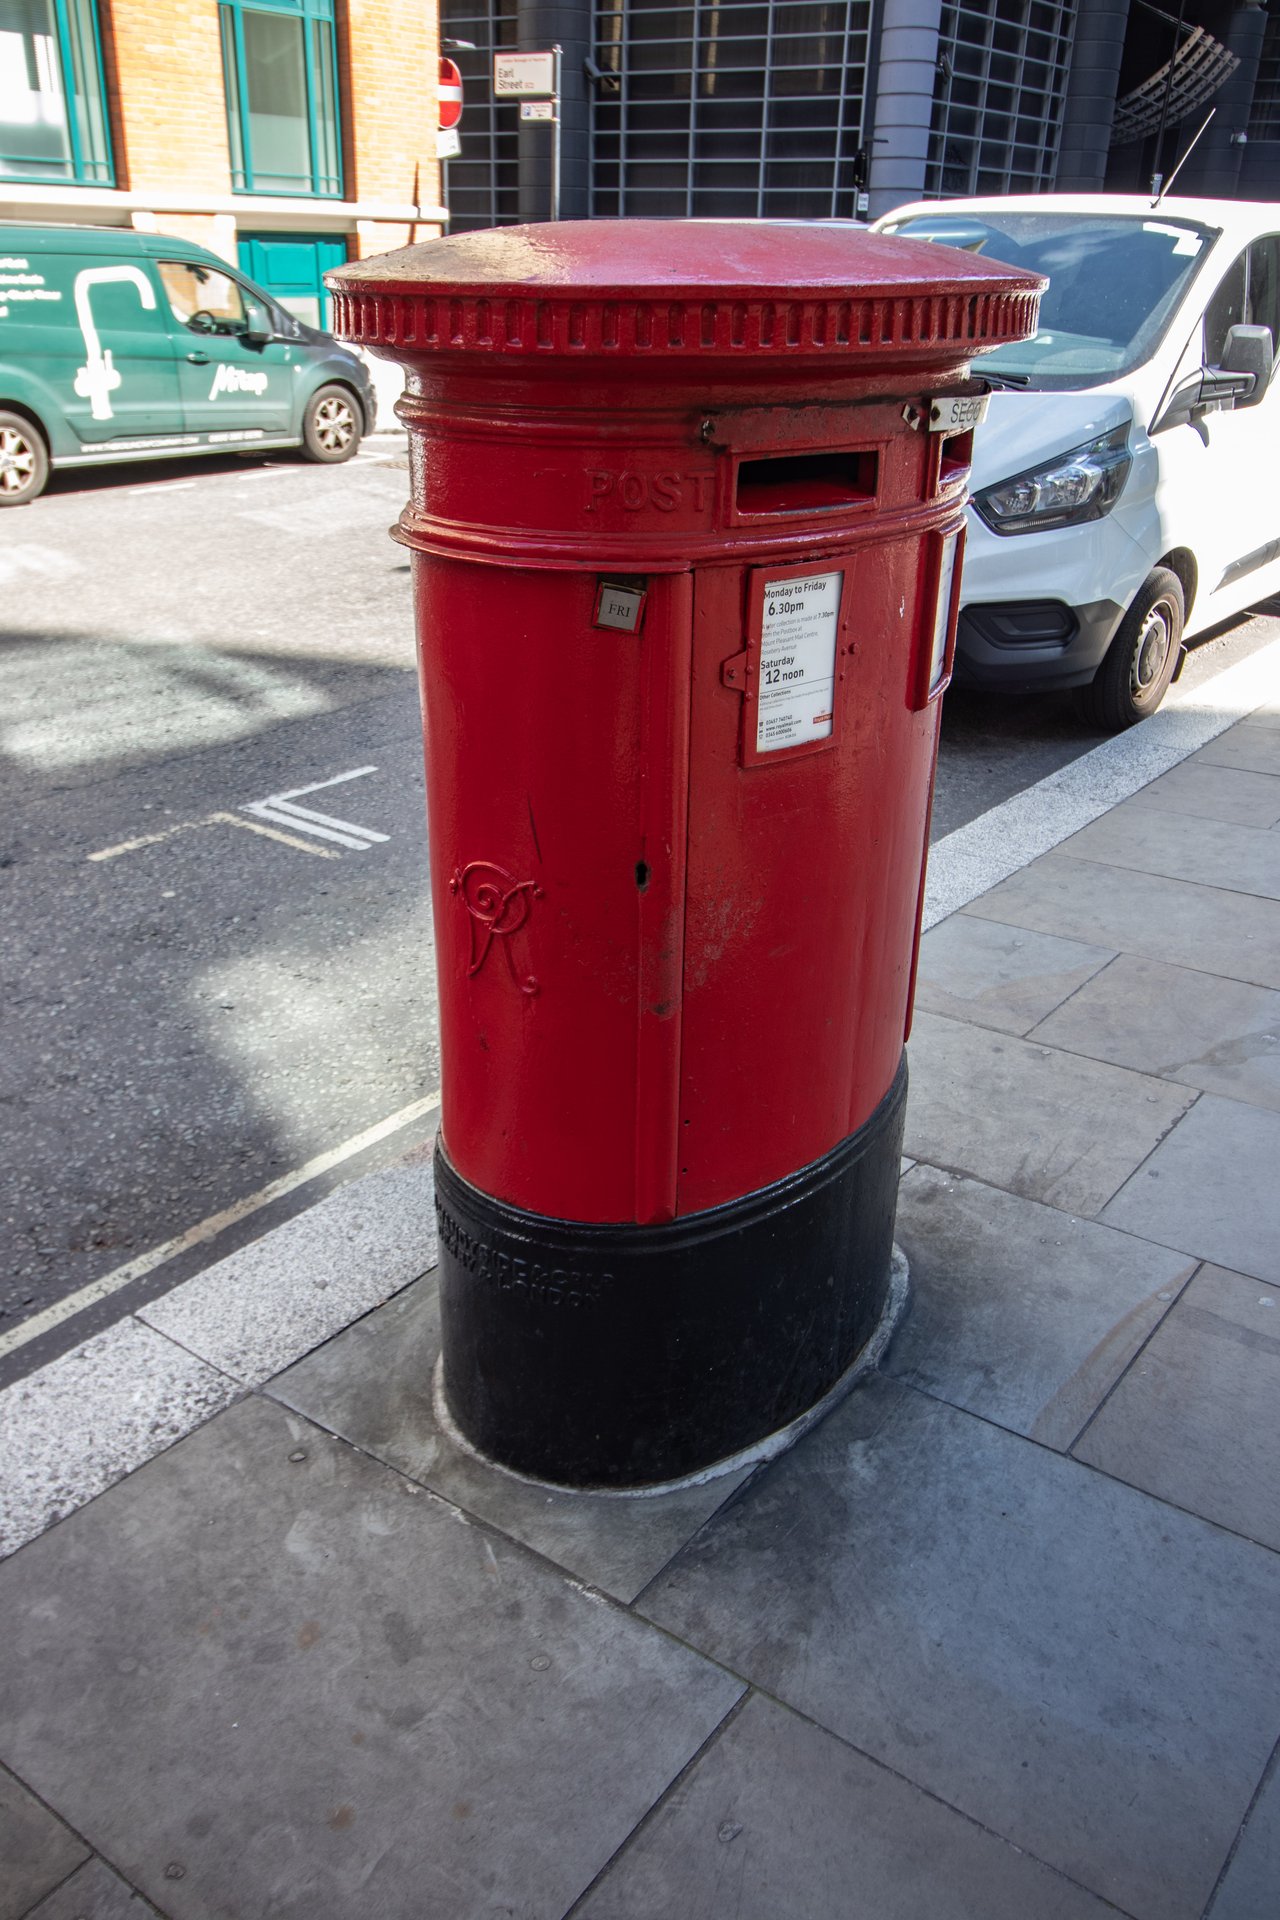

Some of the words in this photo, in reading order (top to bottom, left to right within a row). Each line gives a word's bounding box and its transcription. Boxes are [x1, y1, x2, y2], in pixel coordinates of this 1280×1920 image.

[498, 68, 513, 78] Earl
[499, 79, 523, 89] Street
[584, 469, 716, 512] POST
[764, 588, 793, 600] Monday
[795, 586, 802, 594] to
[804, 581, 827, 592] Friday
[608, 603, 630, 618] FRI
[768, 602, 804, 616] 6.30pm
[818, 611, 834, 619] 7.30pm
[761, 656, 795, 669] Saturday
[765, 669, 780, 684] 12
[782, 669, 804, 681] noon
